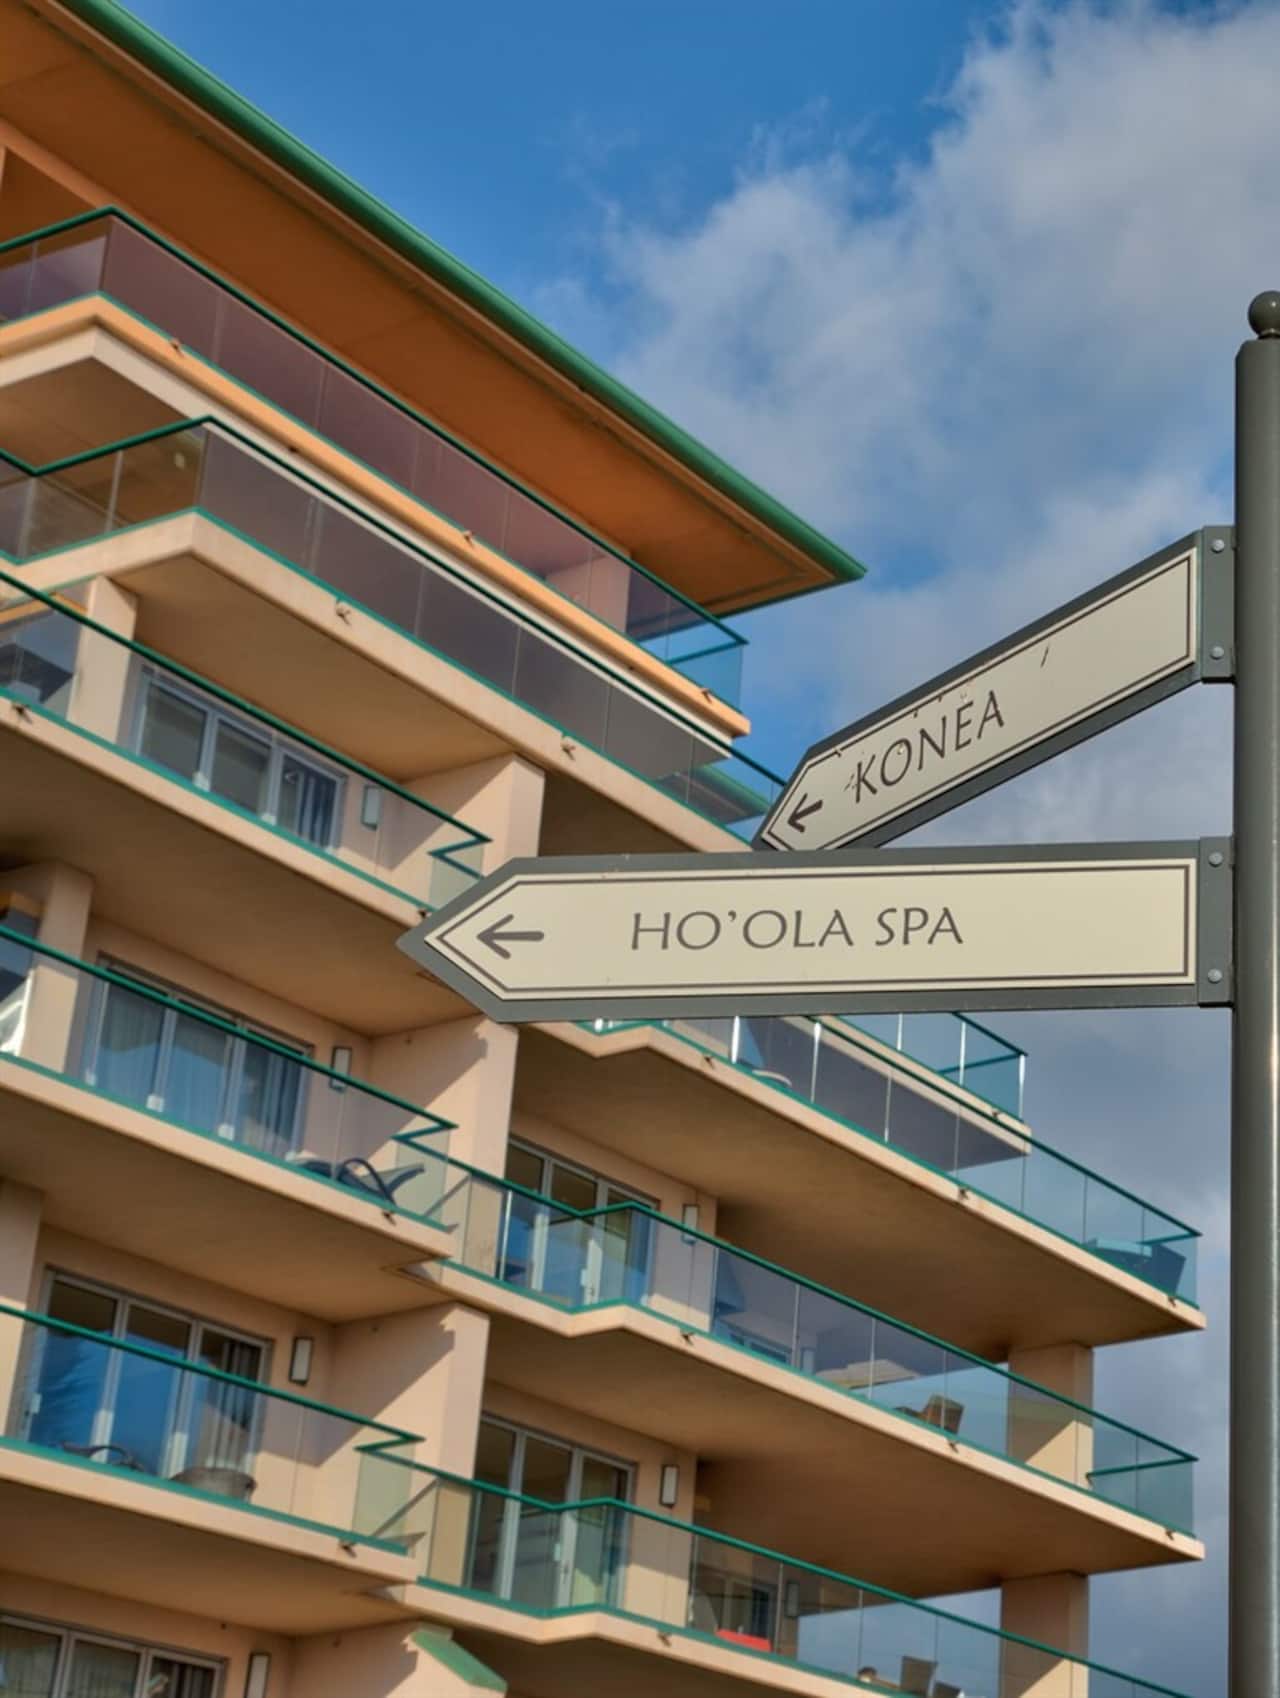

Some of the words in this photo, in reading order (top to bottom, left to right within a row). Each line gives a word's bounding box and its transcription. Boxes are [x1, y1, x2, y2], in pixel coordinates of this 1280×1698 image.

[855, 690, 1004, 803] KONEA
[630, 909, 854, 951] HO'OLA
[875, 907, 963, 947] SPA
